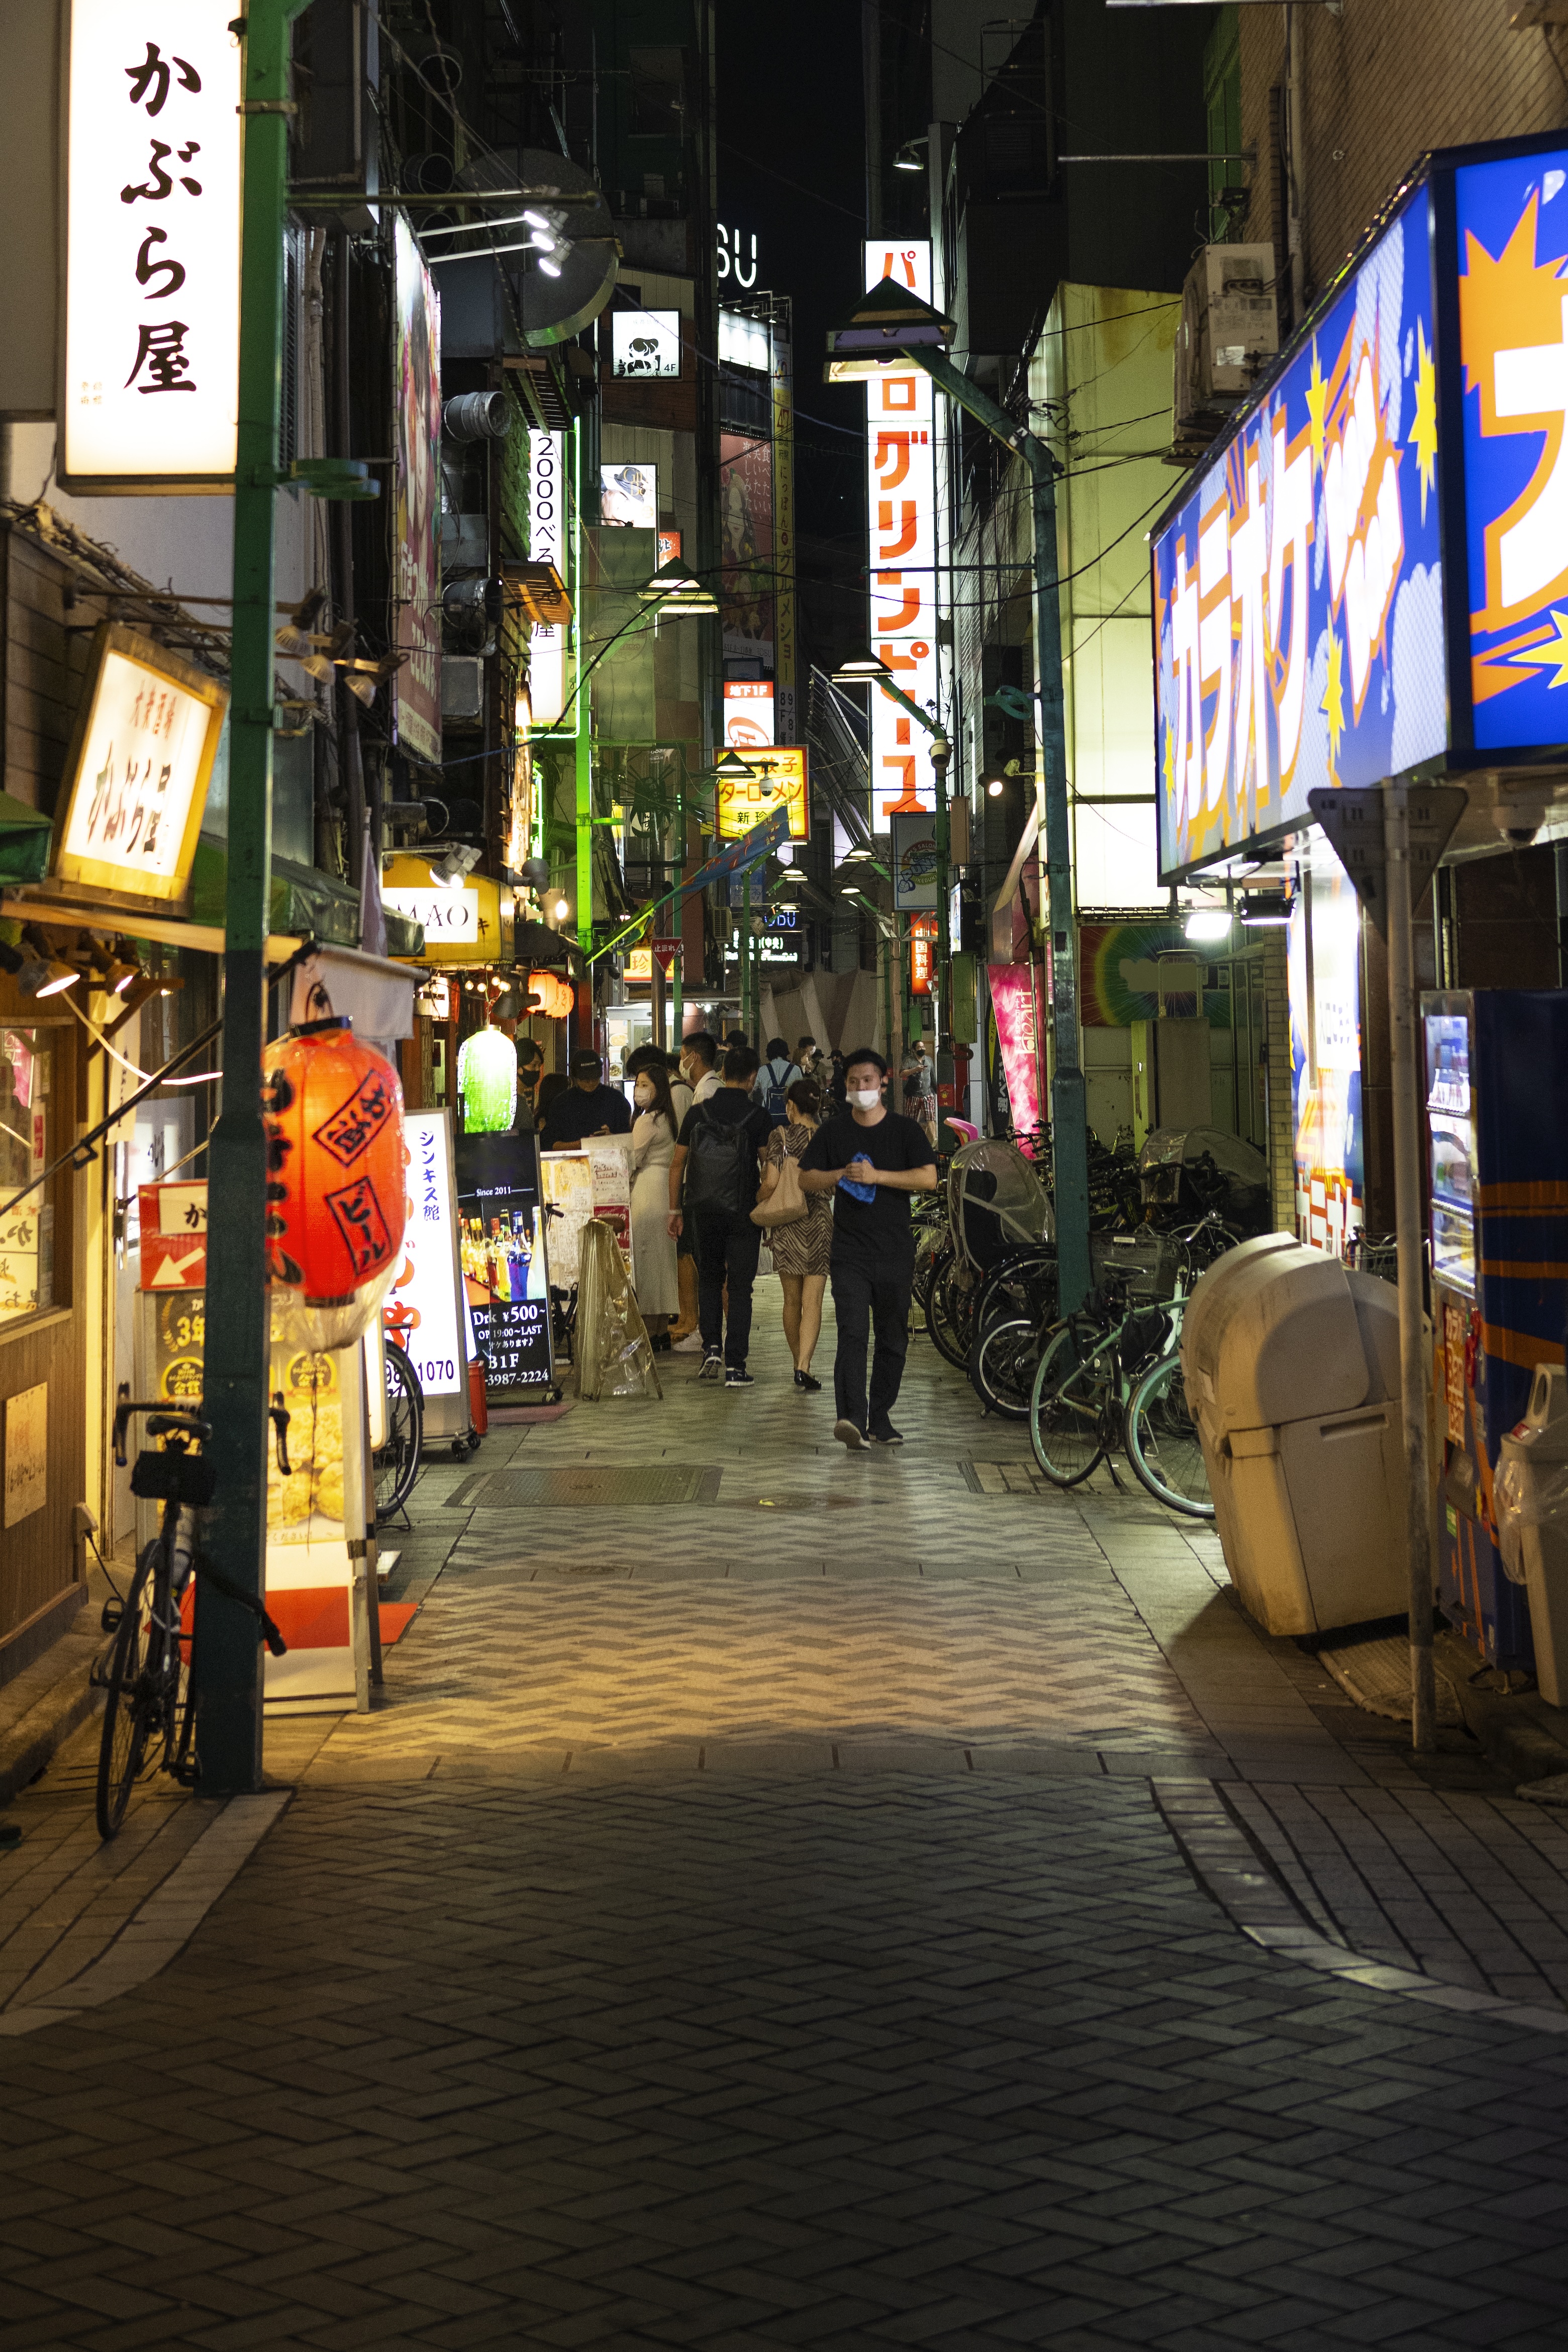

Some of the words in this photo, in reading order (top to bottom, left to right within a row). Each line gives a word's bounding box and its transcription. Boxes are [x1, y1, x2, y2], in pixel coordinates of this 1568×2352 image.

[120, 41, 203, 395] かぶら屋
[664, 363, 676, 372] 4F
[1171, 428, 1313, 827] カラオケ
[729, 685, 768, 697] 地下1F
[720, 781, 802, 804] ターロメン
[654, 944, 676, 952] 止まれ
[632, 952, 649, 973] 珍
[326, 1082, 388, 1154] お酒
[476, 1188, 493, 1197] Since
[494, 1186, 512, 1196] 2011
[338, 1183, 388, 1267] ビール
[488, 1353, 519, 1369] B1F
[485, 1368, 549, 1387] -3987-2224
